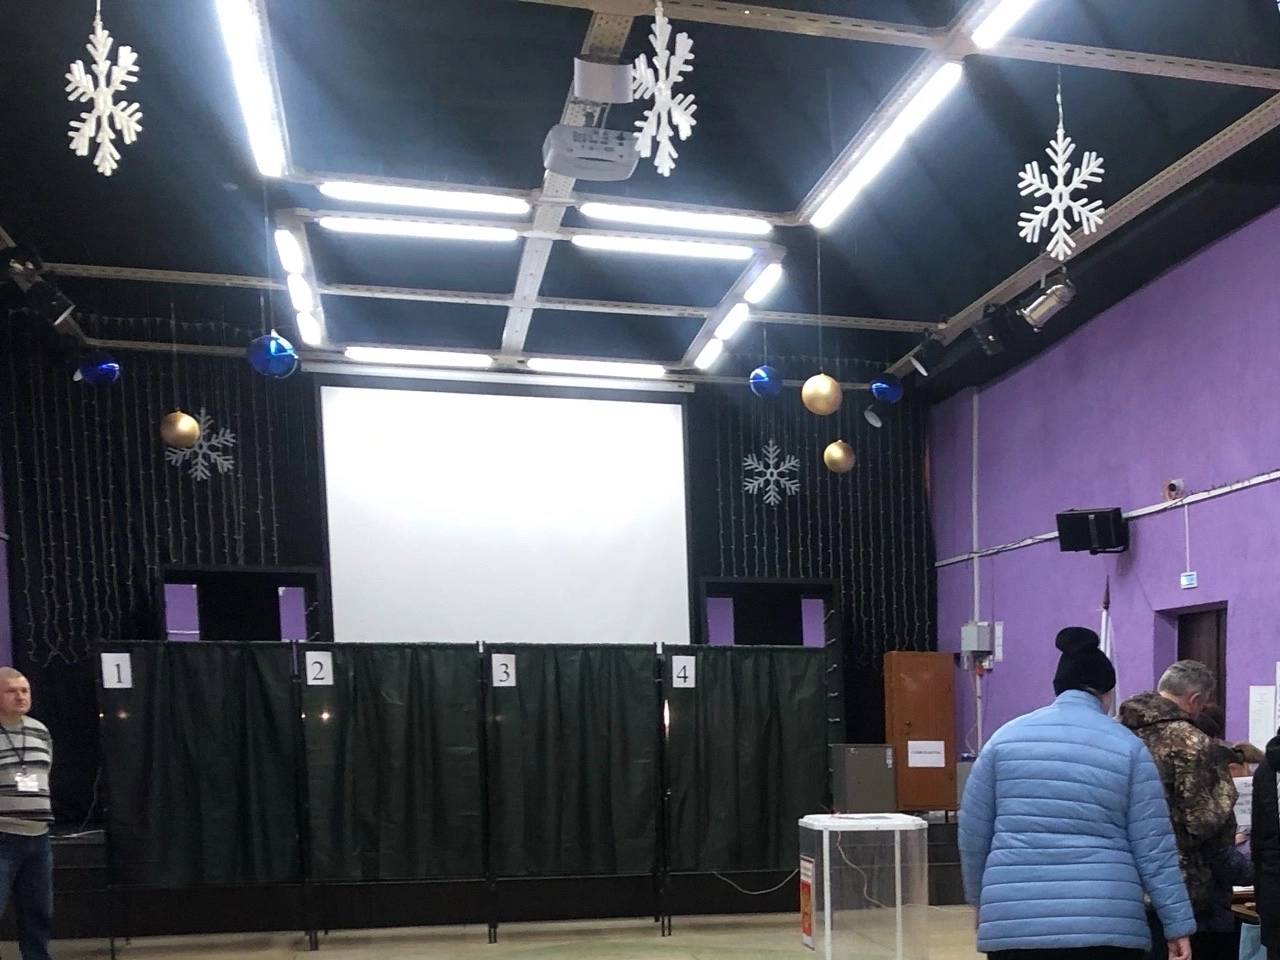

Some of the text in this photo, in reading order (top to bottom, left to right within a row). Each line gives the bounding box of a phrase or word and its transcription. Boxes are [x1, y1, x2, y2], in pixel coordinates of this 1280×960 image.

[113, 662, 124, 684] 1
[311, 660, 326, 681] 2
[499, 663, 511, 683] 3
[676, 664, 689, 684] 4
